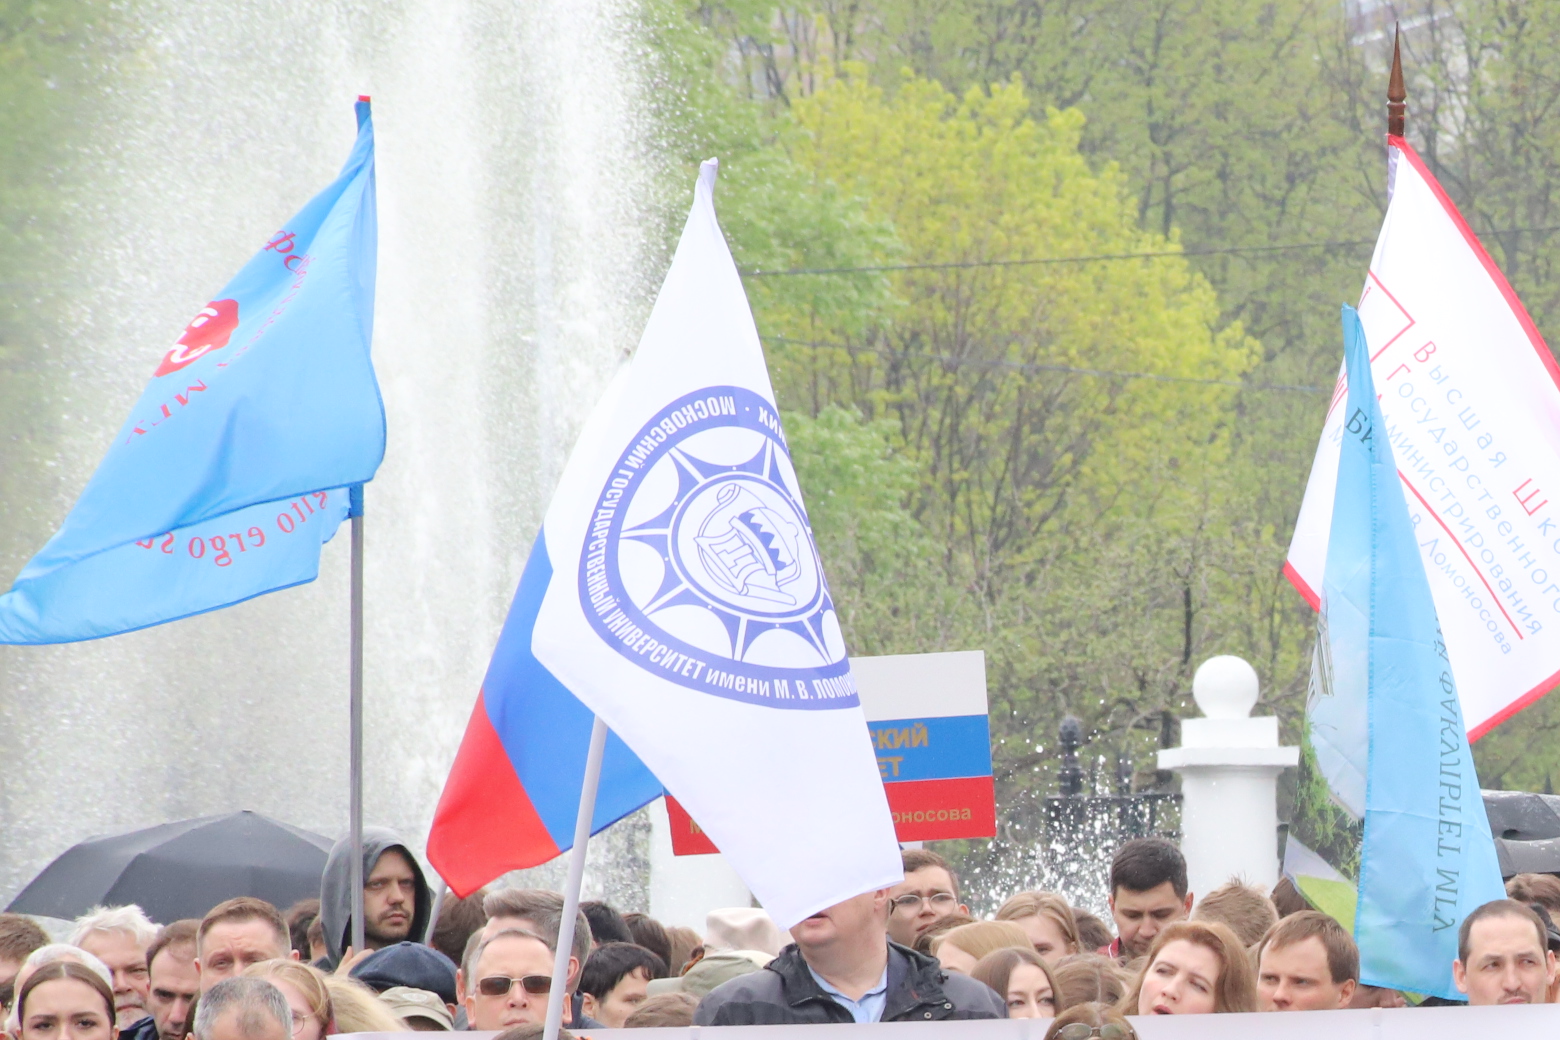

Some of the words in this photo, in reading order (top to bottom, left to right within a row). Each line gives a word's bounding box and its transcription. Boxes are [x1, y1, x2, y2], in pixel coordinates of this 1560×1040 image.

[624, 395, 736, 471] МОСКОВСКИЙ
[586, 467, 635, 618] ГОСУДАРСТВЕННЫЙ
[1376, 394, 1543, 638] министрирования
[1420, 537, 1512, 655] Ломоносова
[602, 609, 706, 681] УНИВЕРСИТЕТ
[705, 665, 771, 698] имени
[892, 807, 973, 825] оносова
